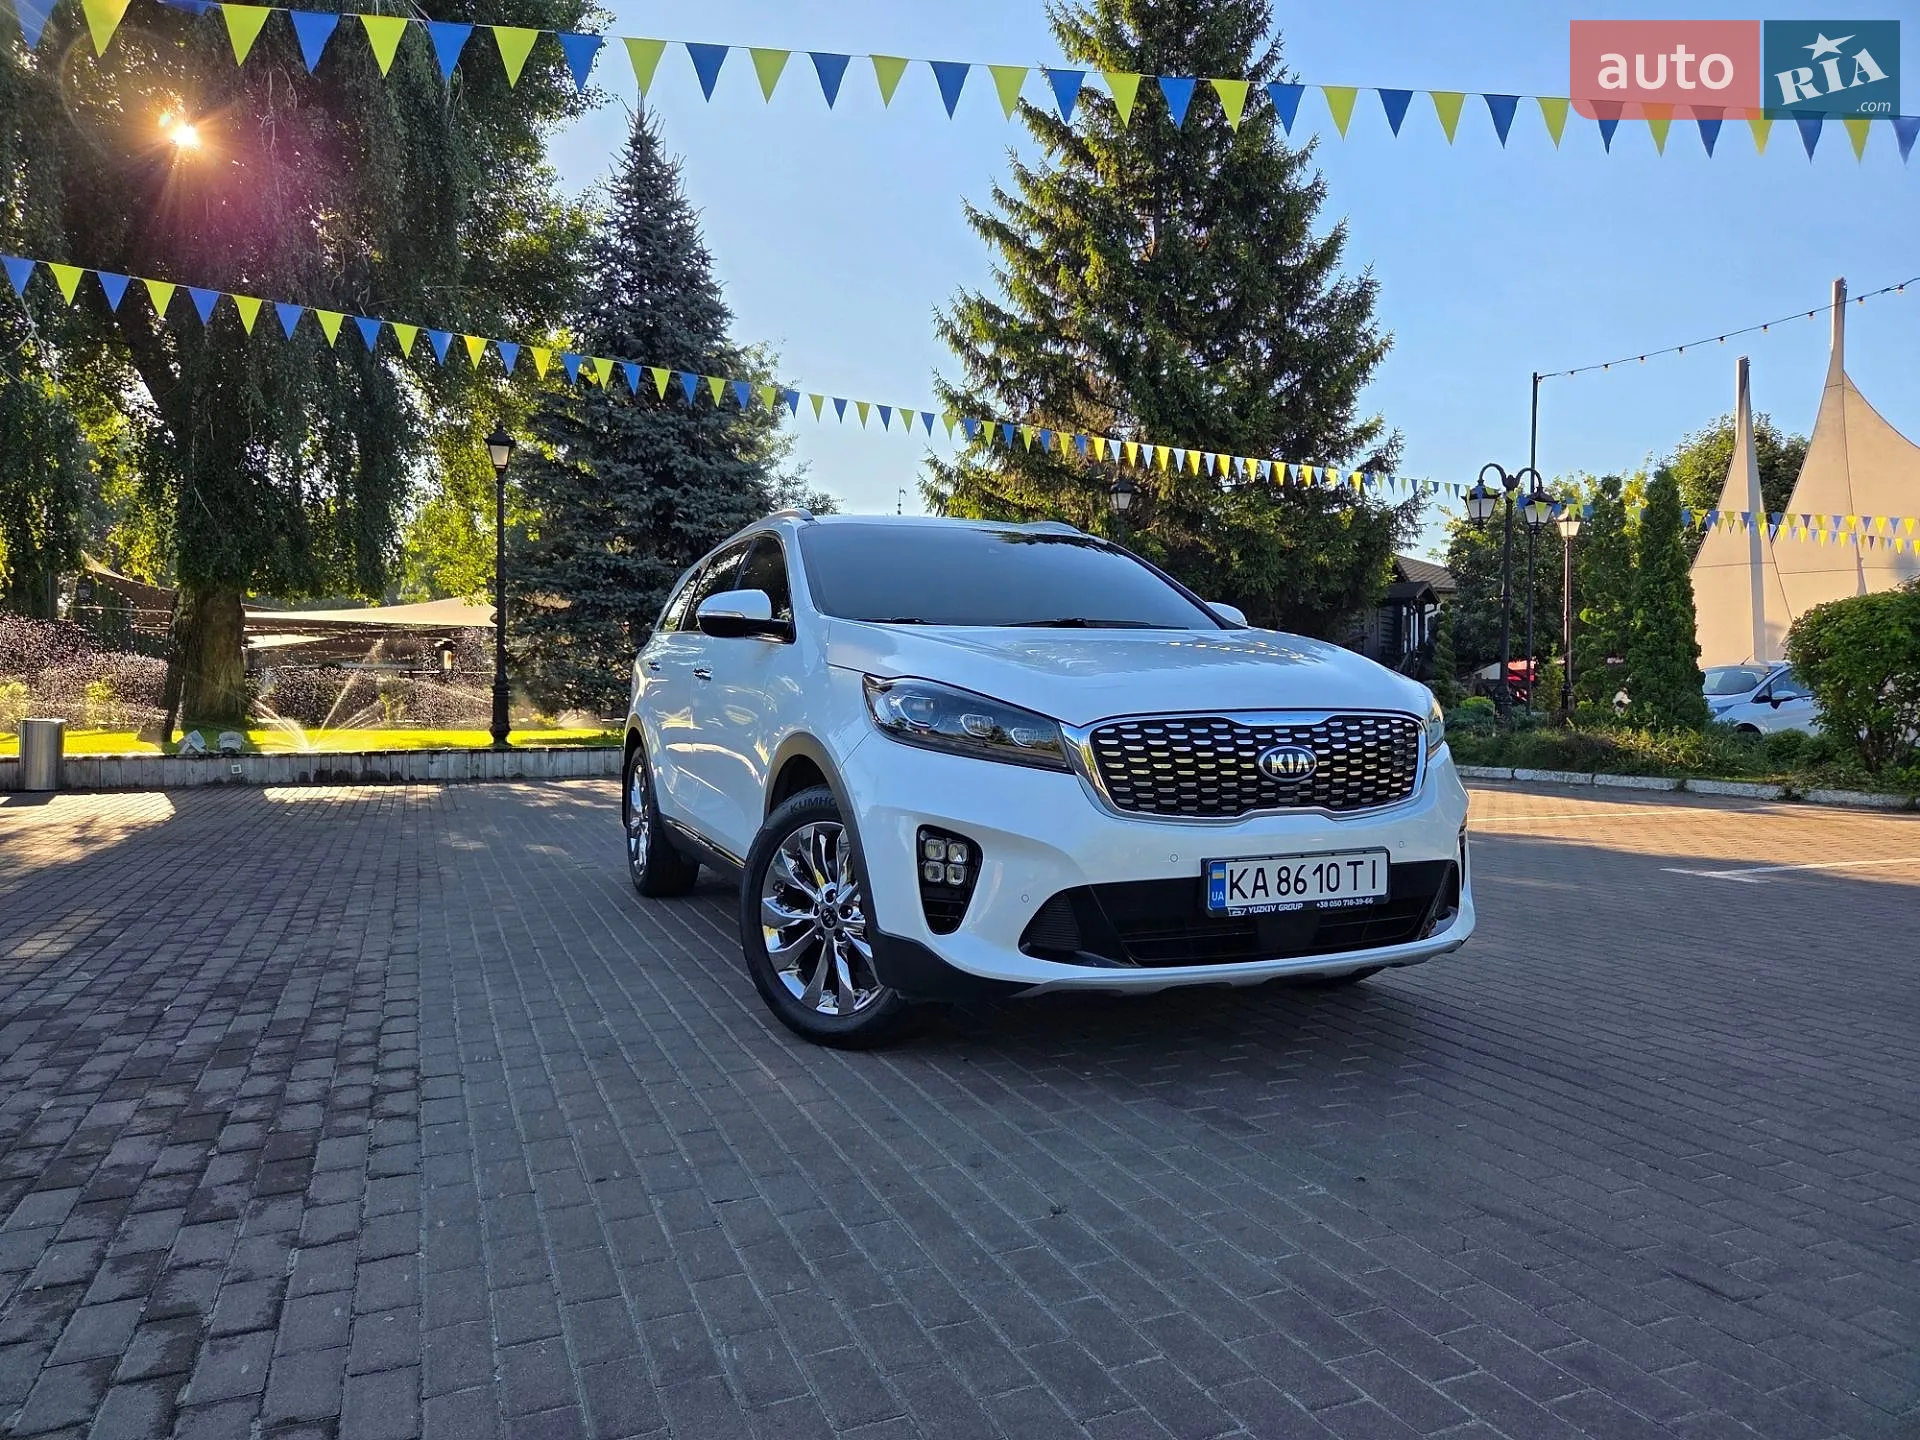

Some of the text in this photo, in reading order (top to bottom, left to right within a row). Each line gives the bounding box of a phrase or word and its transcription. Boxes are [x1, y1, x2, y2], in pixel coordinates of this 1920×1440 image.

[1270, 753, 1310, 774] KIA
[1229, 859, 1377, 900] KA 8610 TI
[1211, 891, 1225, 902] UA
[1278, 902, 1303, 911] GROUP
